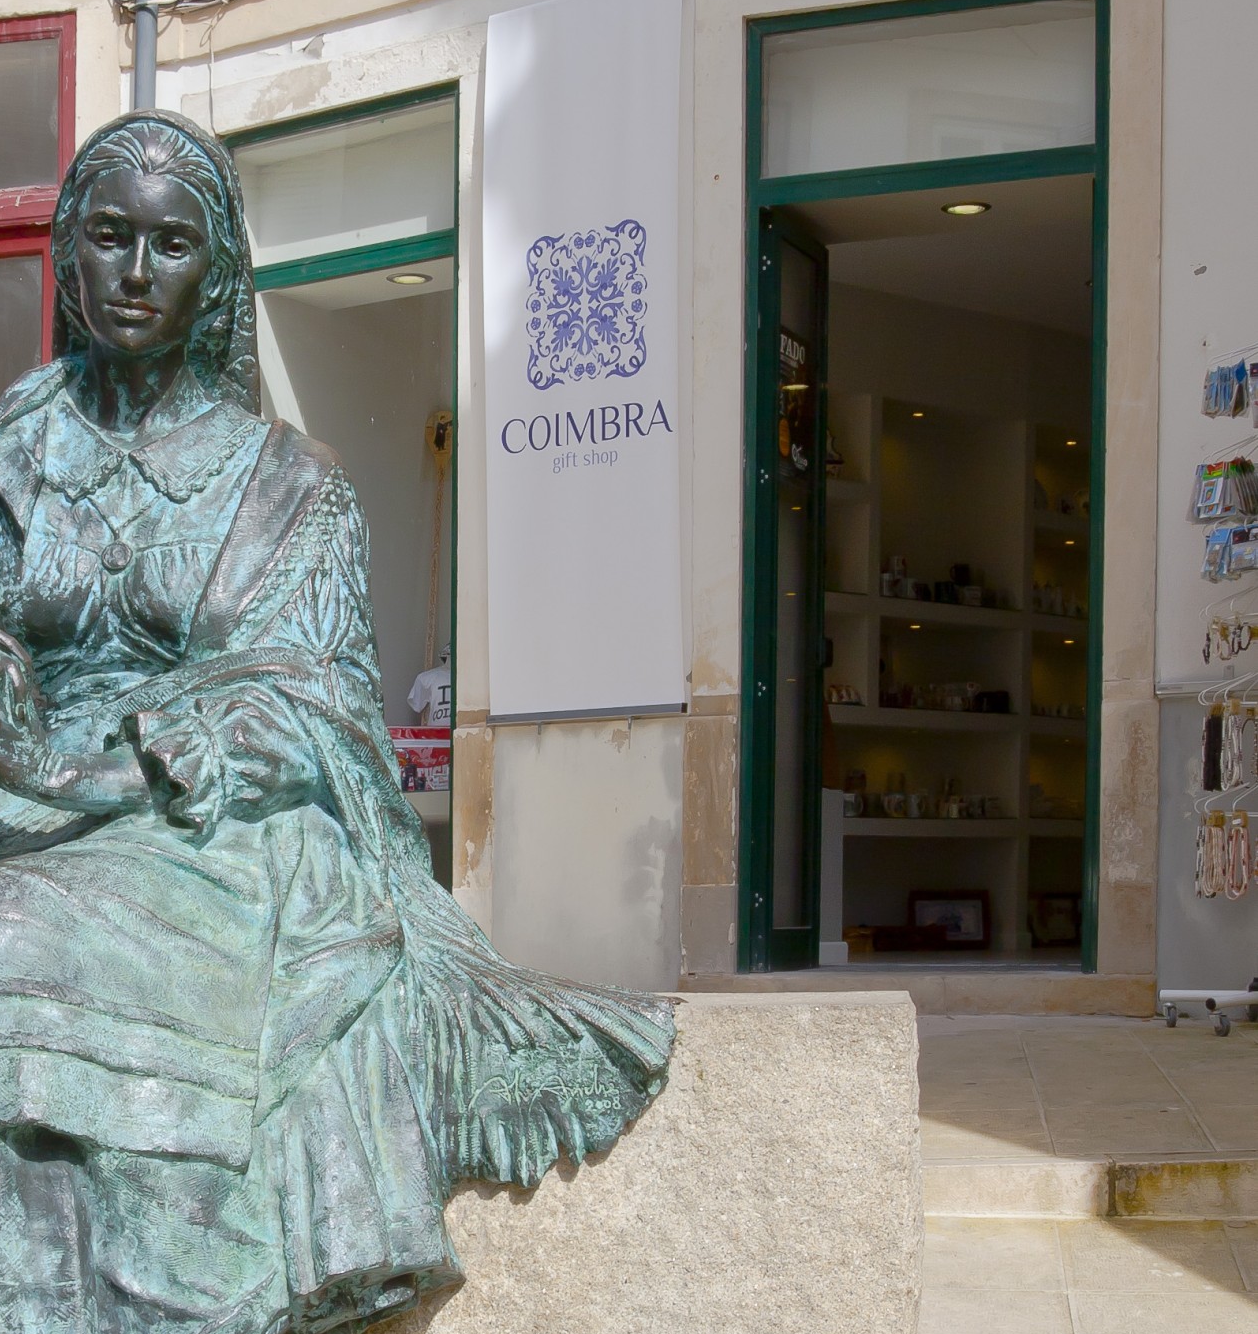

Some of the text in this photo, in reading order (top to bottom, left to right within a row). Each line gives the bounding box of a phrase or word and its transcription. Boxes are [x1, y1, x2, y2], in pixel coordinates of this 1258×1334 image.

[780, 333, 806, 365] FADO
[501, 399, 674, 455] COIMBRA
[552, 448, 619, 474] gift shop
